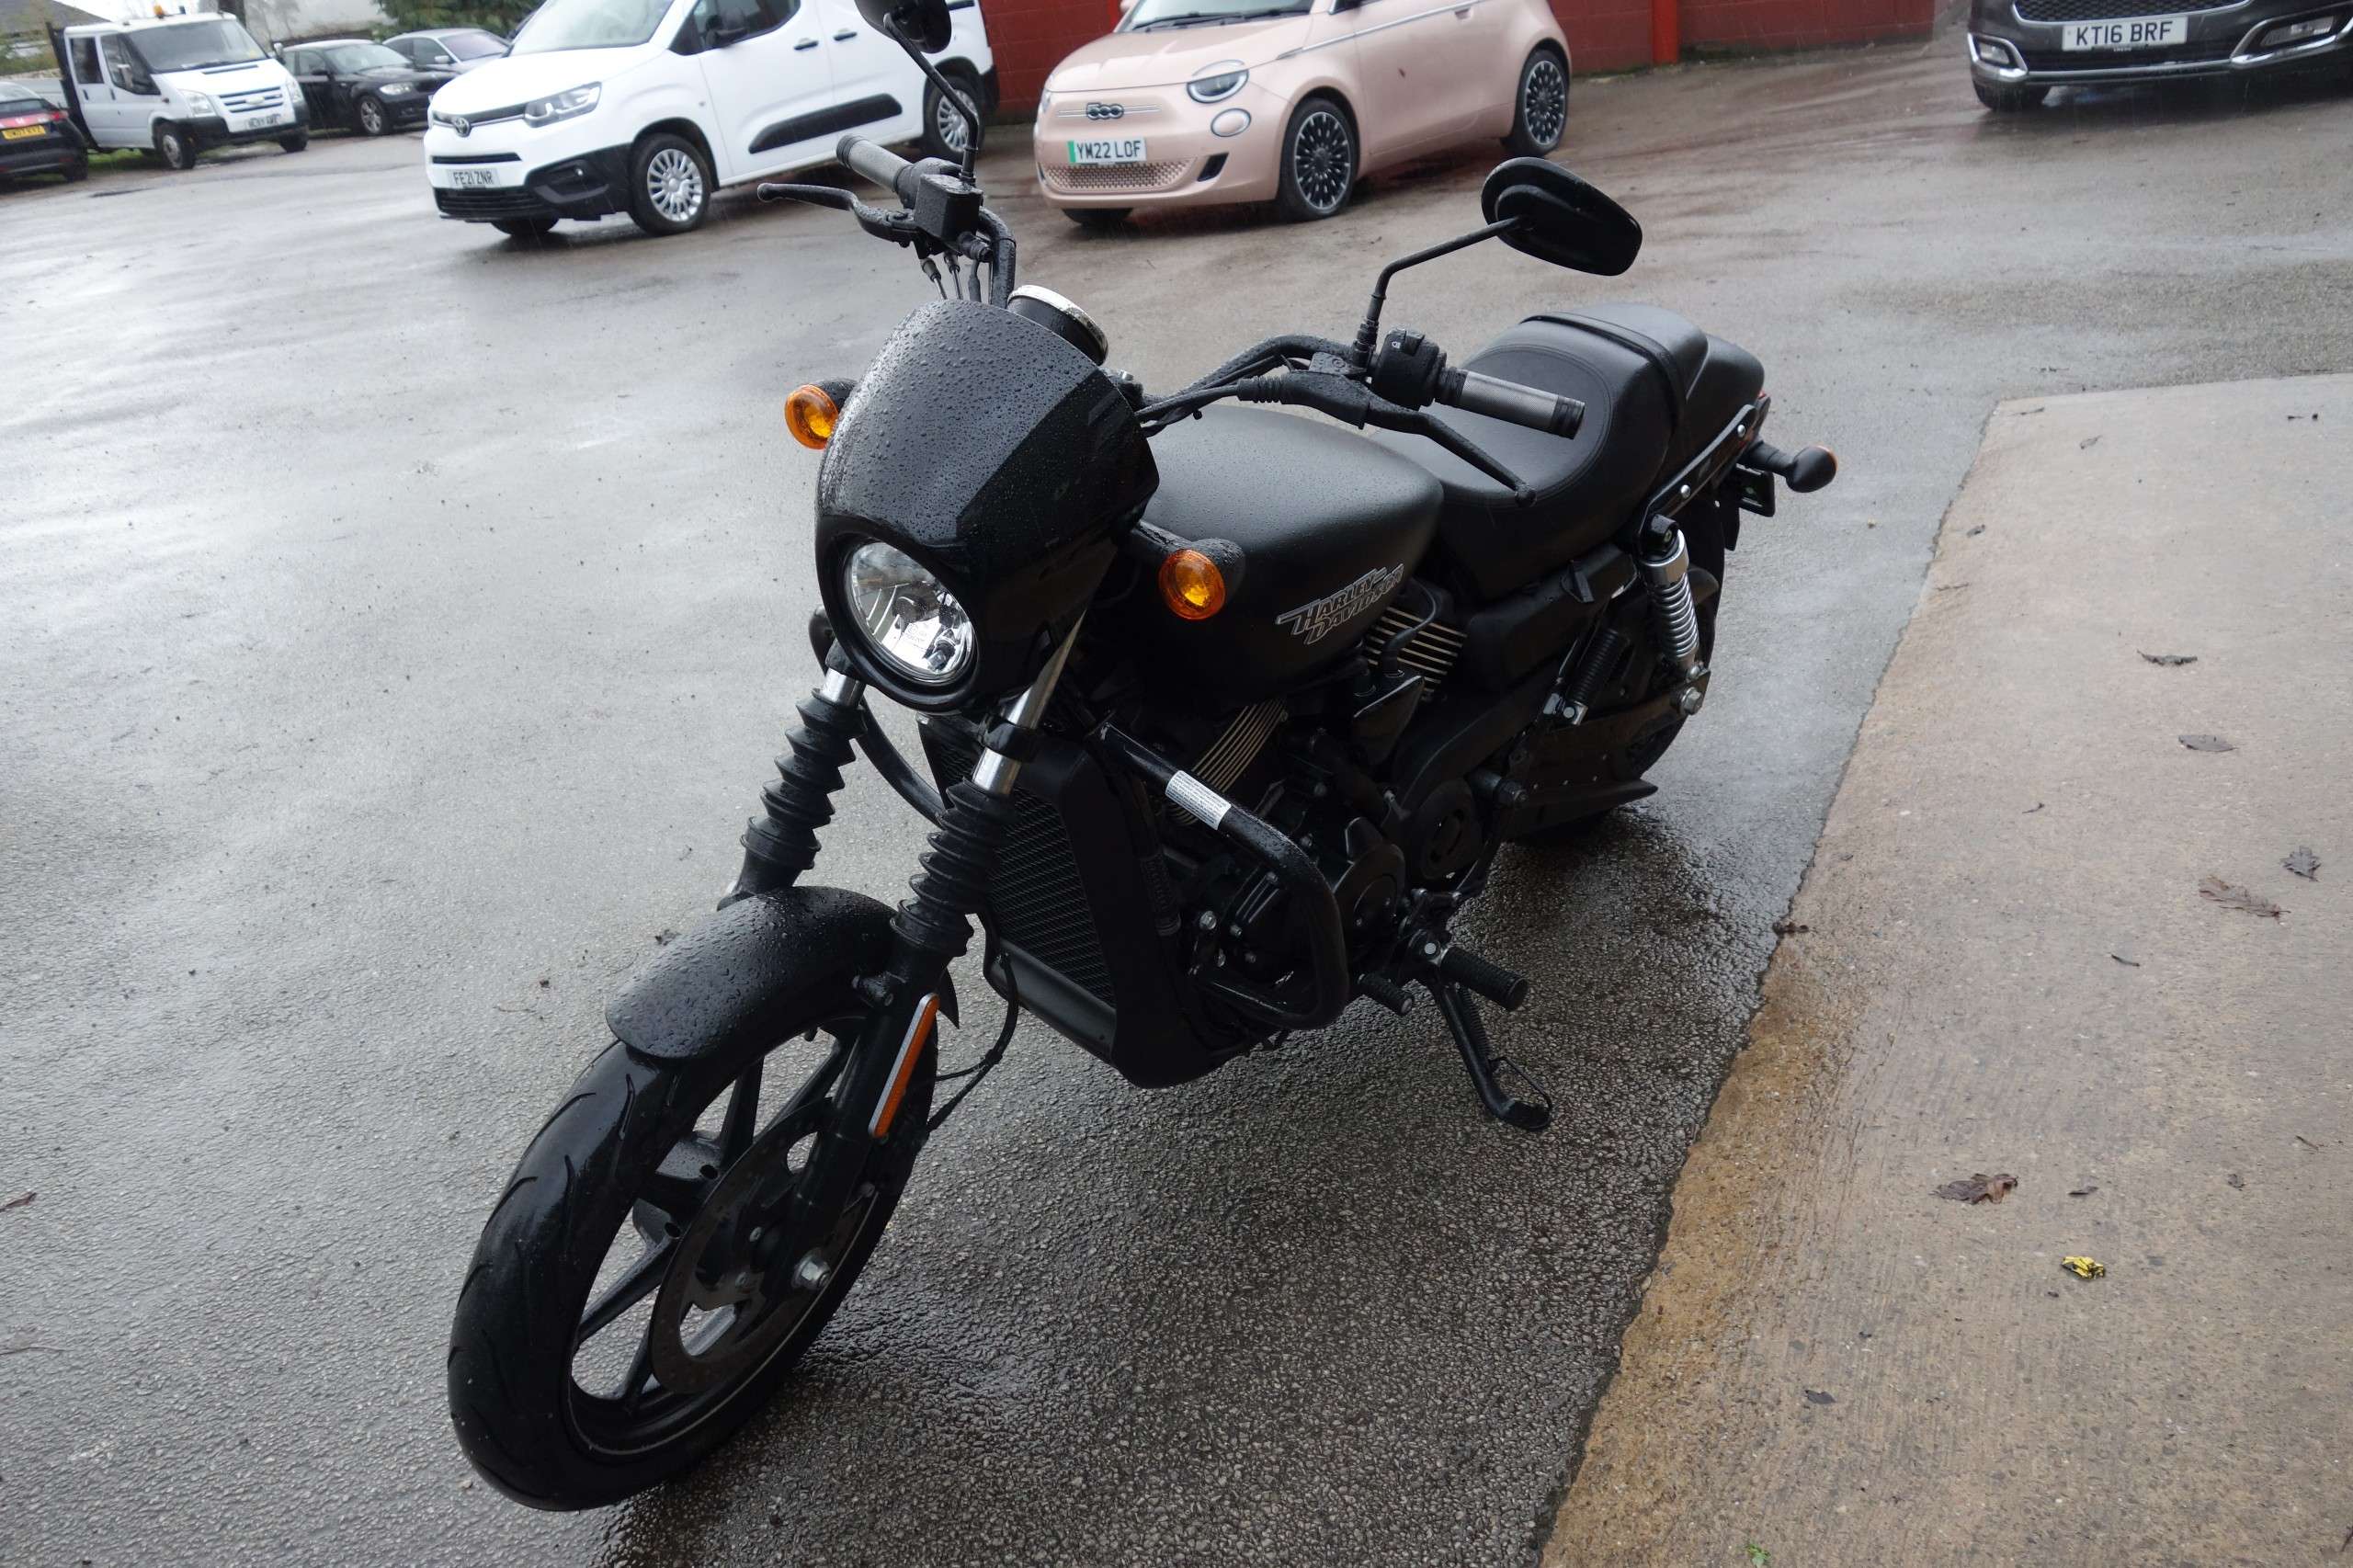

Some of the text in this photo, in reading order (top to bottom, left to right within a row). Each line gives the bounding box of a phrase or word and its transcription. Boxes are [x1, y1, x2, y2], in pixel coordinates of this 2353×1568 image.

[2076, 21, 2173, 45] KT16 BRF
[1086, 102, 1124, 120] 500
[1115, 141, 1142, 158] LOF
[453, 170, 494, 185] FE21 ZNR
[1303, 562, 1404, 645] DAVIDSON
